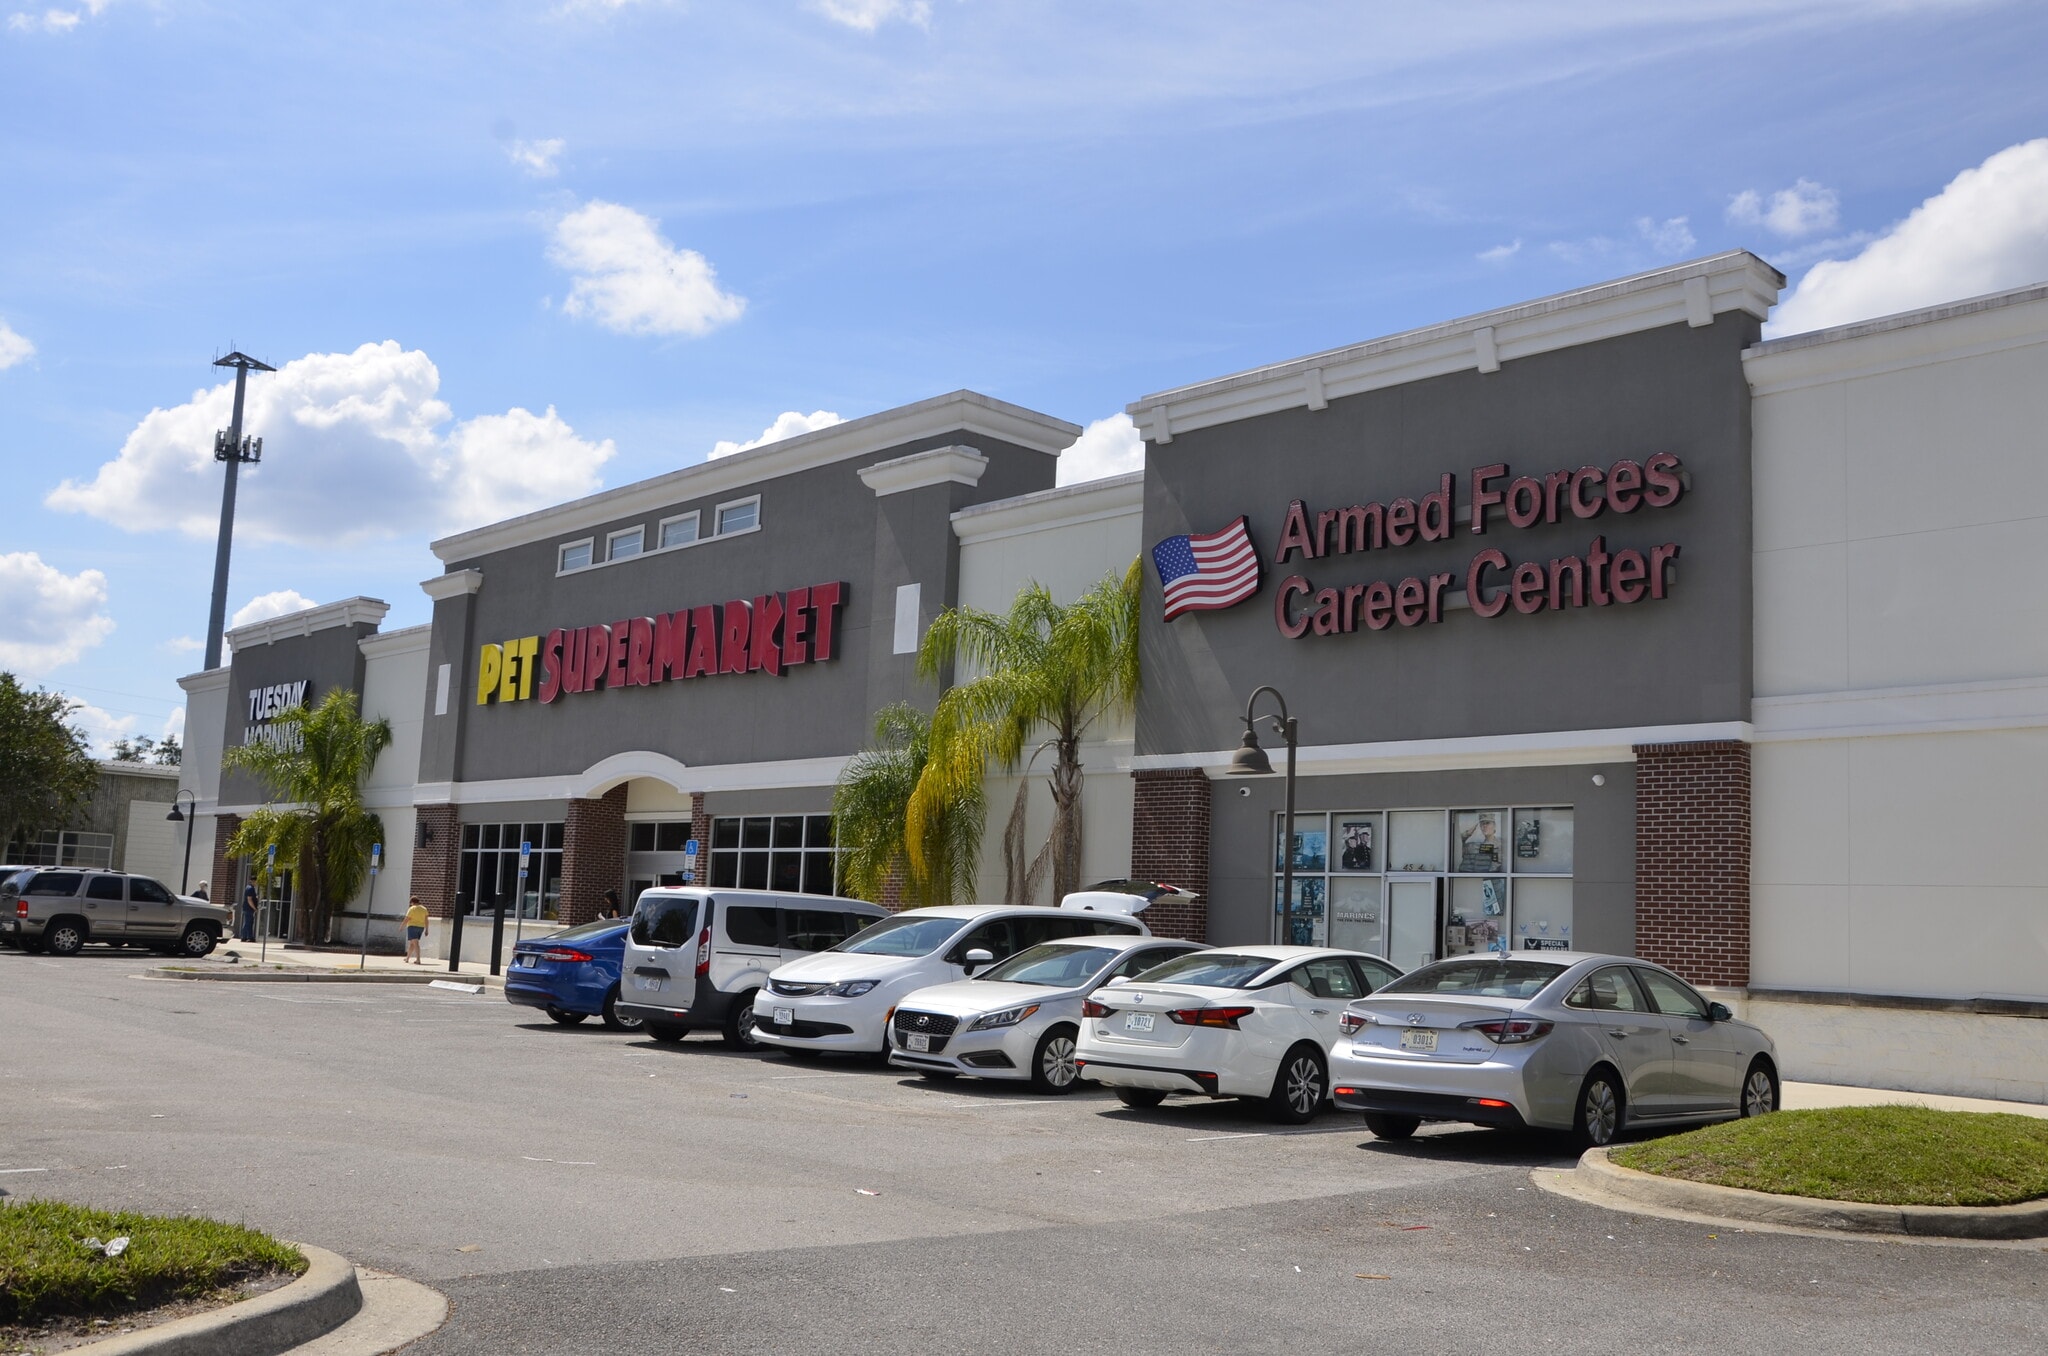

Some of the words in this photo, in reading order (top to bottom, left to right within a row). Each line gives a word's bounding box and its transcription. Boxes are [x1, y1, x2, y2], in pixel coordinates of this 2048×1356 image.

[1275, 472, 1456, 563] Armed
[1471, 452, 1684, 534] Forces
[1274, 571, 1455, 639] Career
[1467, 535, 1681, 617] Center
[477, 635, 543, 706] PET
[538, 581, 850, 704] SUPERMARKET
[249, 680, 308, 720] TUESDAY
